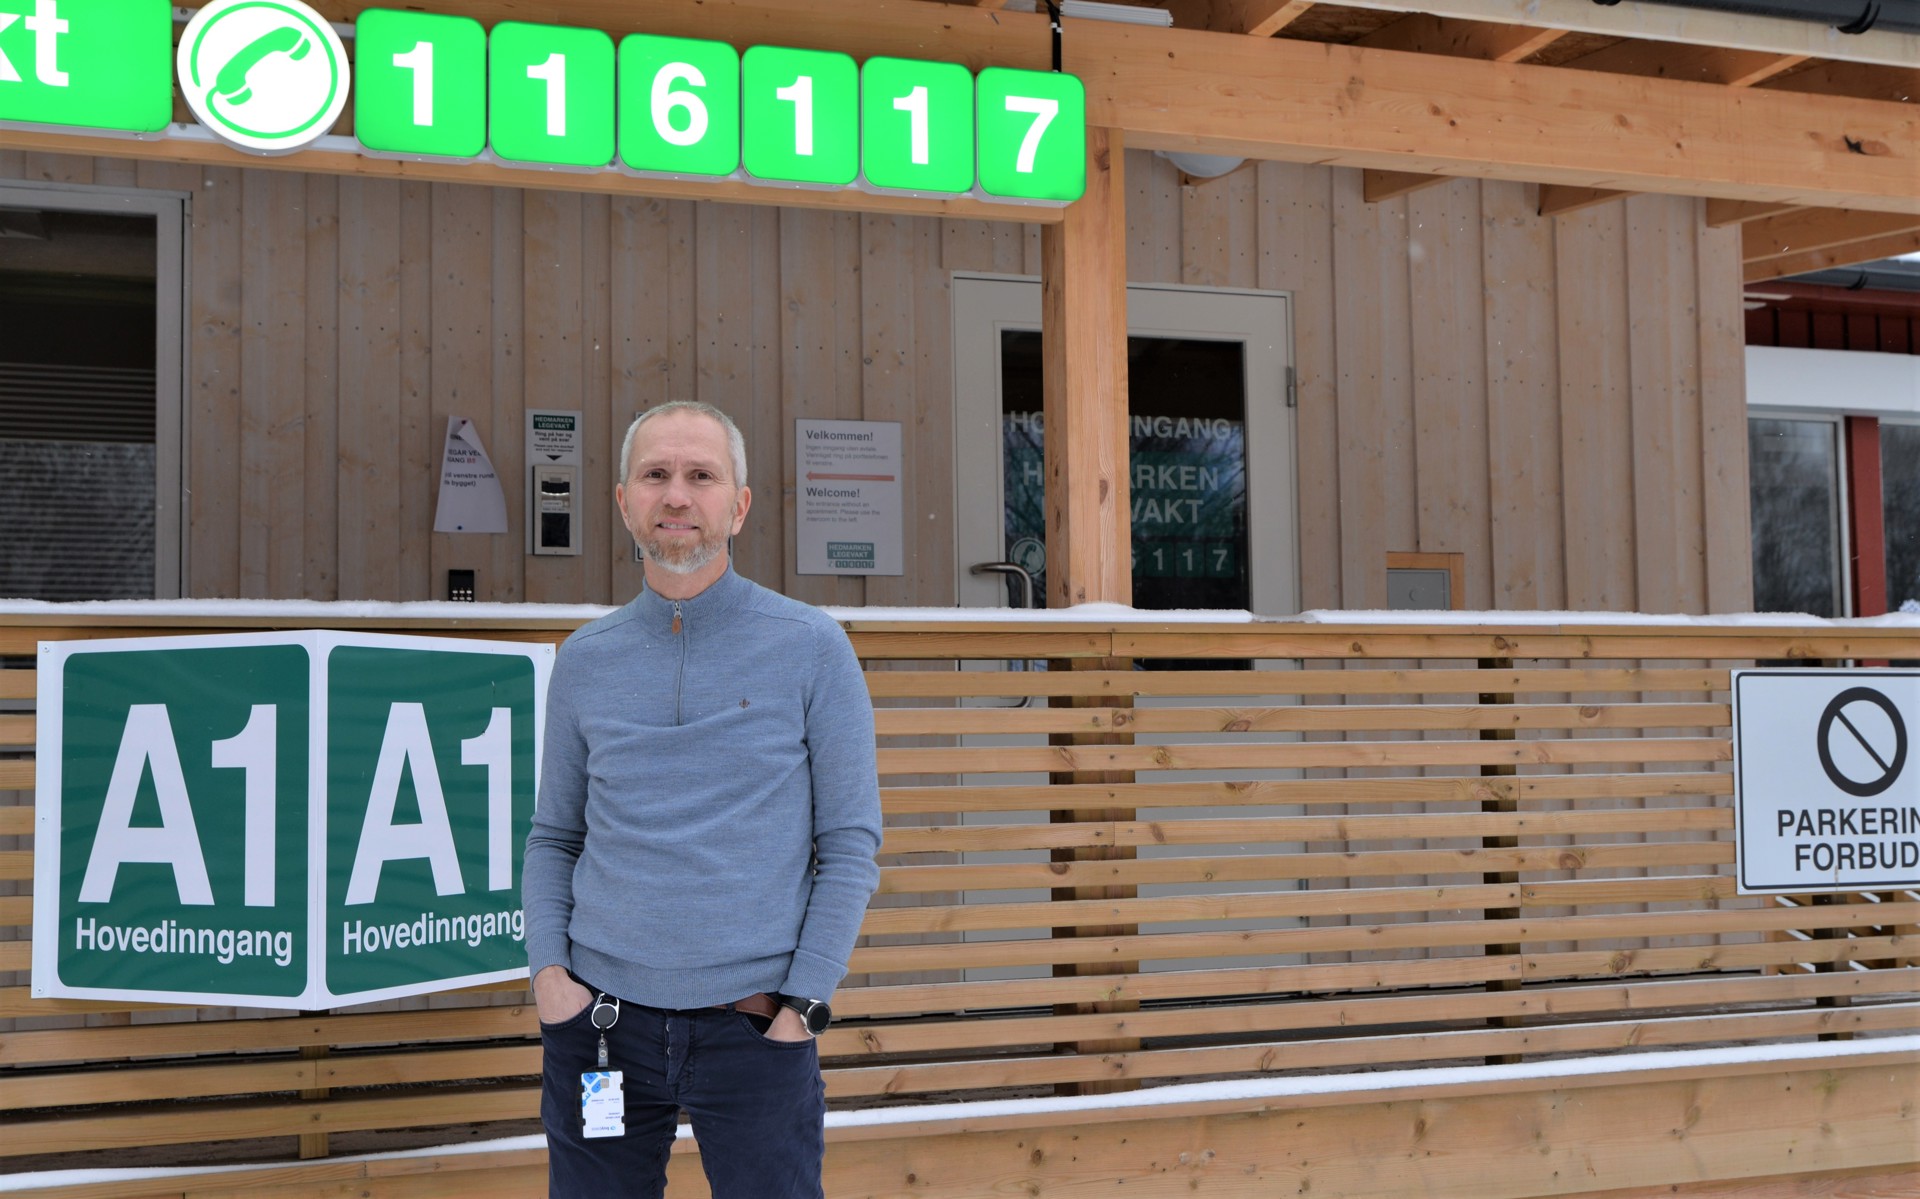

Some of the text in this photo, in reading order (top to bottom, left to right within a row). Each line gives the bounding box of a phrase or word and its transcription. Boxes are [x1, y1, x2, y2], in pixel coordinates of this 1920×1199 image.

[806, 430, 873, 441] Velkommen!
[1010, 410, 1231, 440] HONGANG
[806, 487, 860, 498] Welcome!
[77, 703, 277, 907] A1
[344, 702, 512, 906] A1
[1795, 841, 1919, 871] FORBUD
[76, 917, 292, 966] Hovedinngang
[343, 909, 525, 955] Hovedinngang
